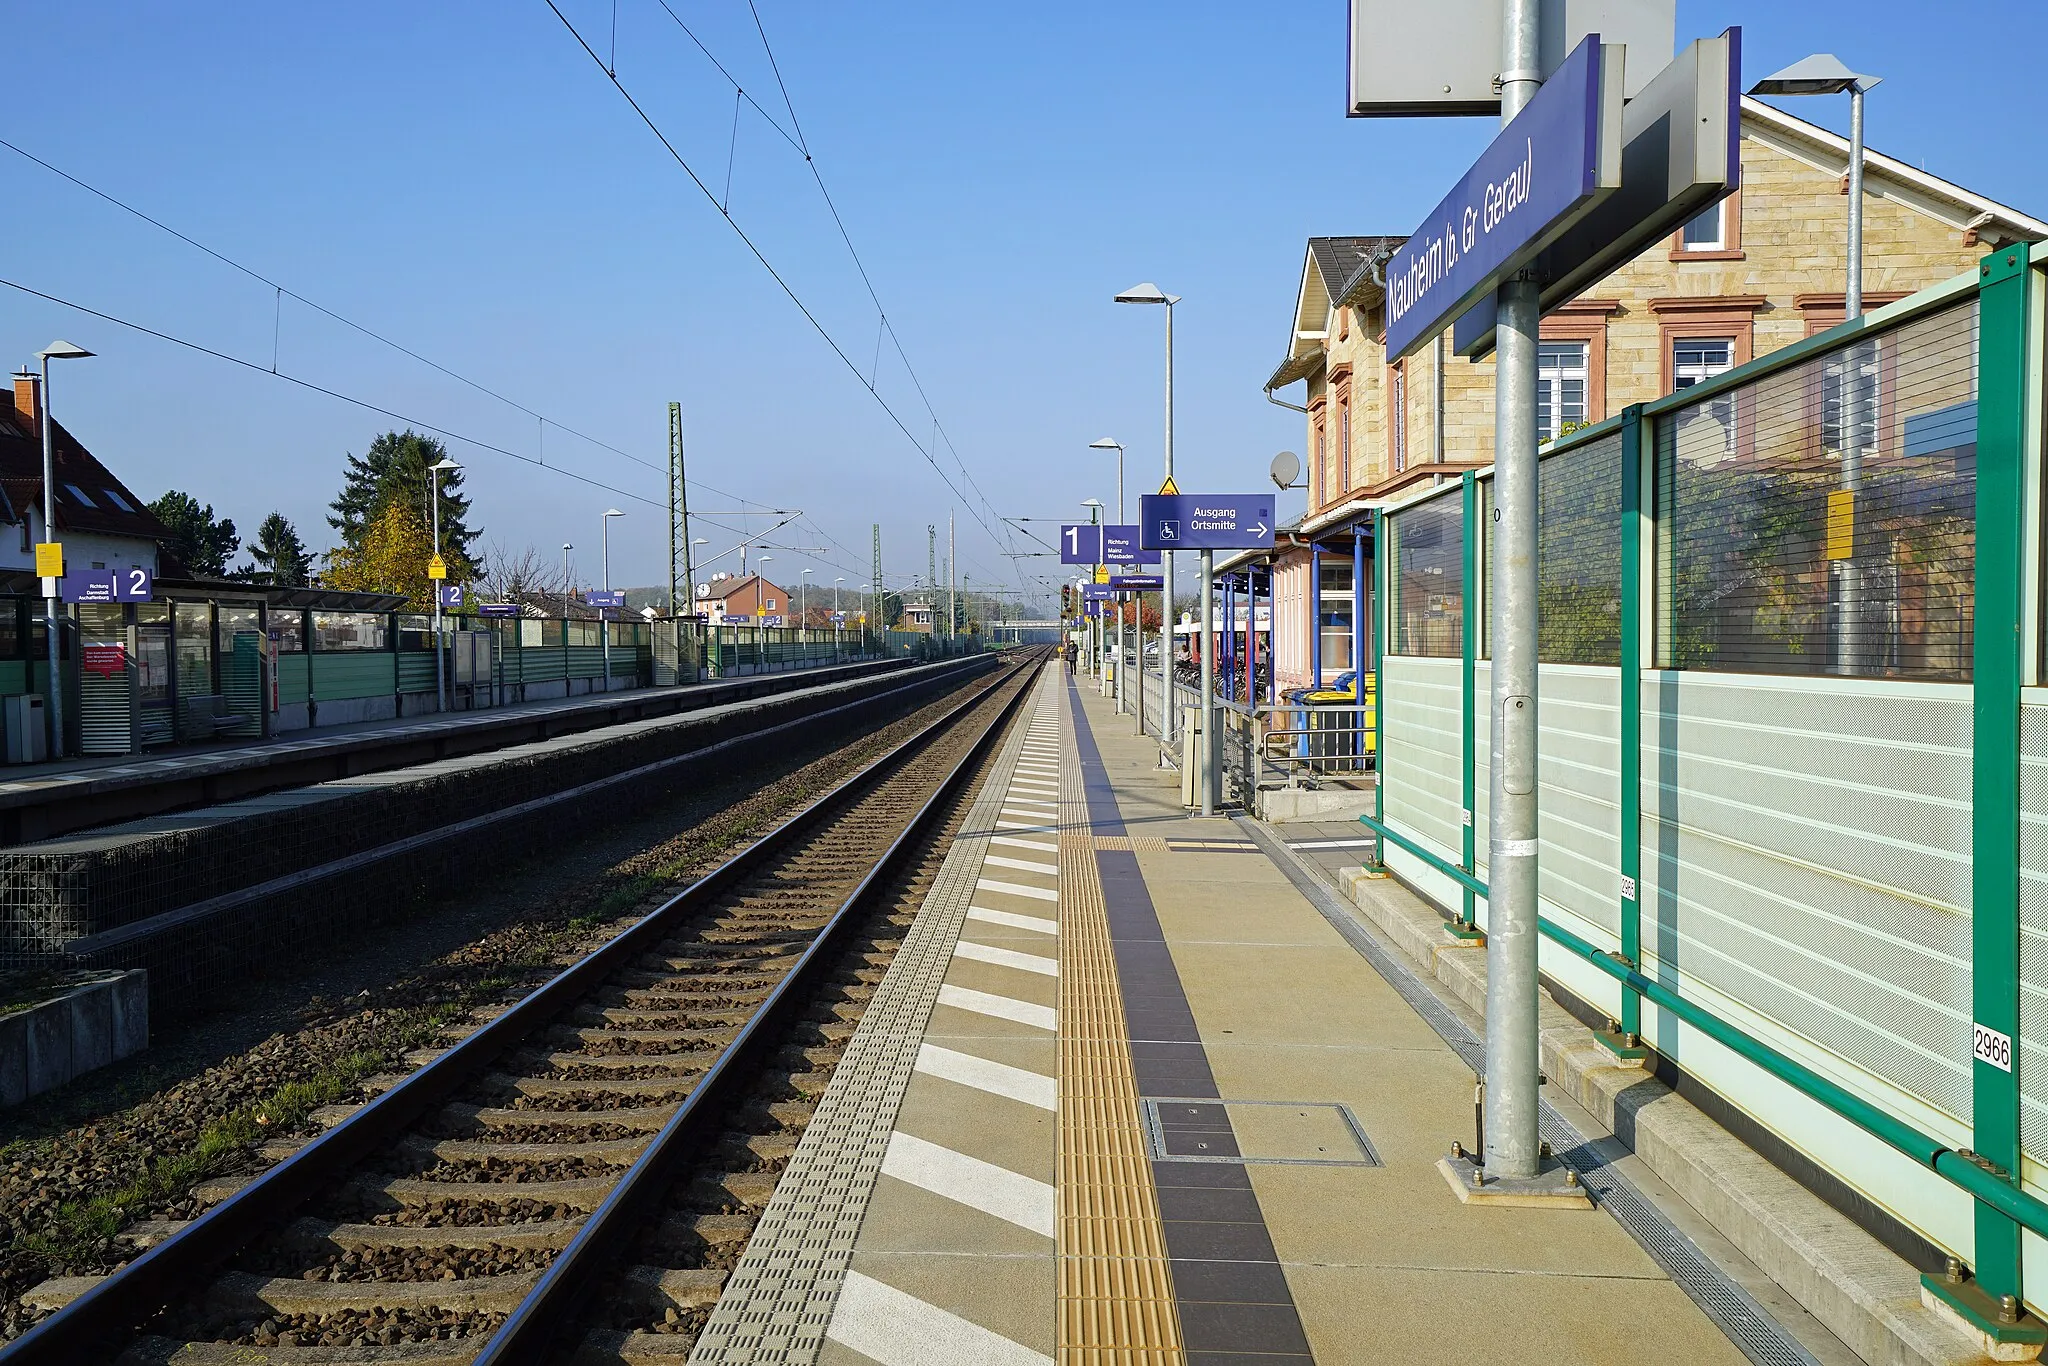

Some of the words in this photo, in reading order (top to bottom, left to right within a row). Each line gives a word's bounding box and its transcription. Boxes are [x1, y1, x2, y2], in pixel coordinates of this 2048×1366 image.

[1388, 236, 1442, 328] Nauheim
[1445, 221, 1459, 277] (b.
[1462, 205, 1479, 254] Gr
[1483, 136, 1532, 234] Gerau)
[1193, 507, 1236, 519] Ausgang
[1191, 520, 1236, 530] Ortsmitte
[1065, 526, 1078, 555] 1
[129, 569, 147, 595] 2
[449, 586, 461, 603] 2
[1085, 600, 1091, 612] 1
[775, 616, 781, 624] 2
[1975, 1029, 2010, 1066] 2966
